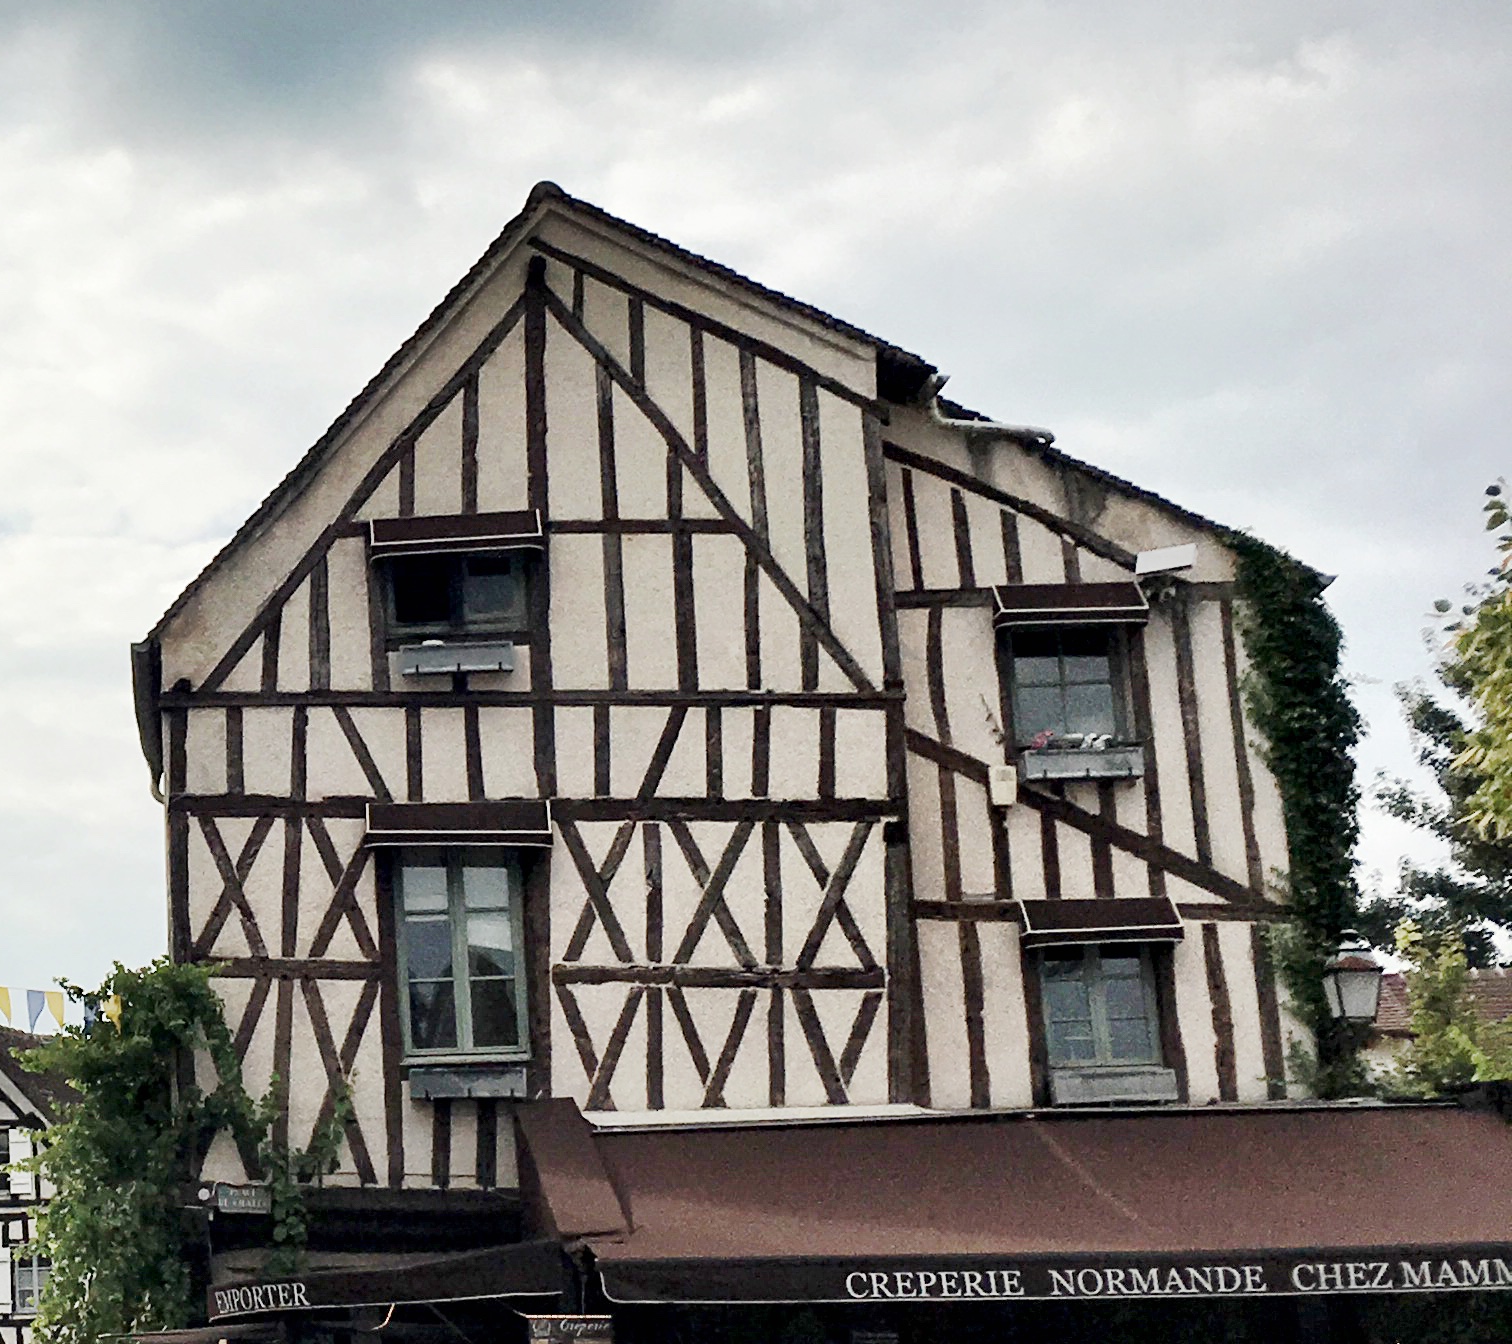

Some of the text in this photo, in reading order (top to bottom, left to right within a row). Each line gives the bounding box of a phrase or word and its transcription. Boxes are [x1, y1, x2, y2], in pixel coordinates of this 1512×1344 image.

[845, 1270, 1025, 1298] CREPERIE
[1048, 1265, 1268, 1297] NORMANDE
[1291, 1261, 1393, 1292] CHEZ
[214, 1282, 310, 1314] EMPORTER
